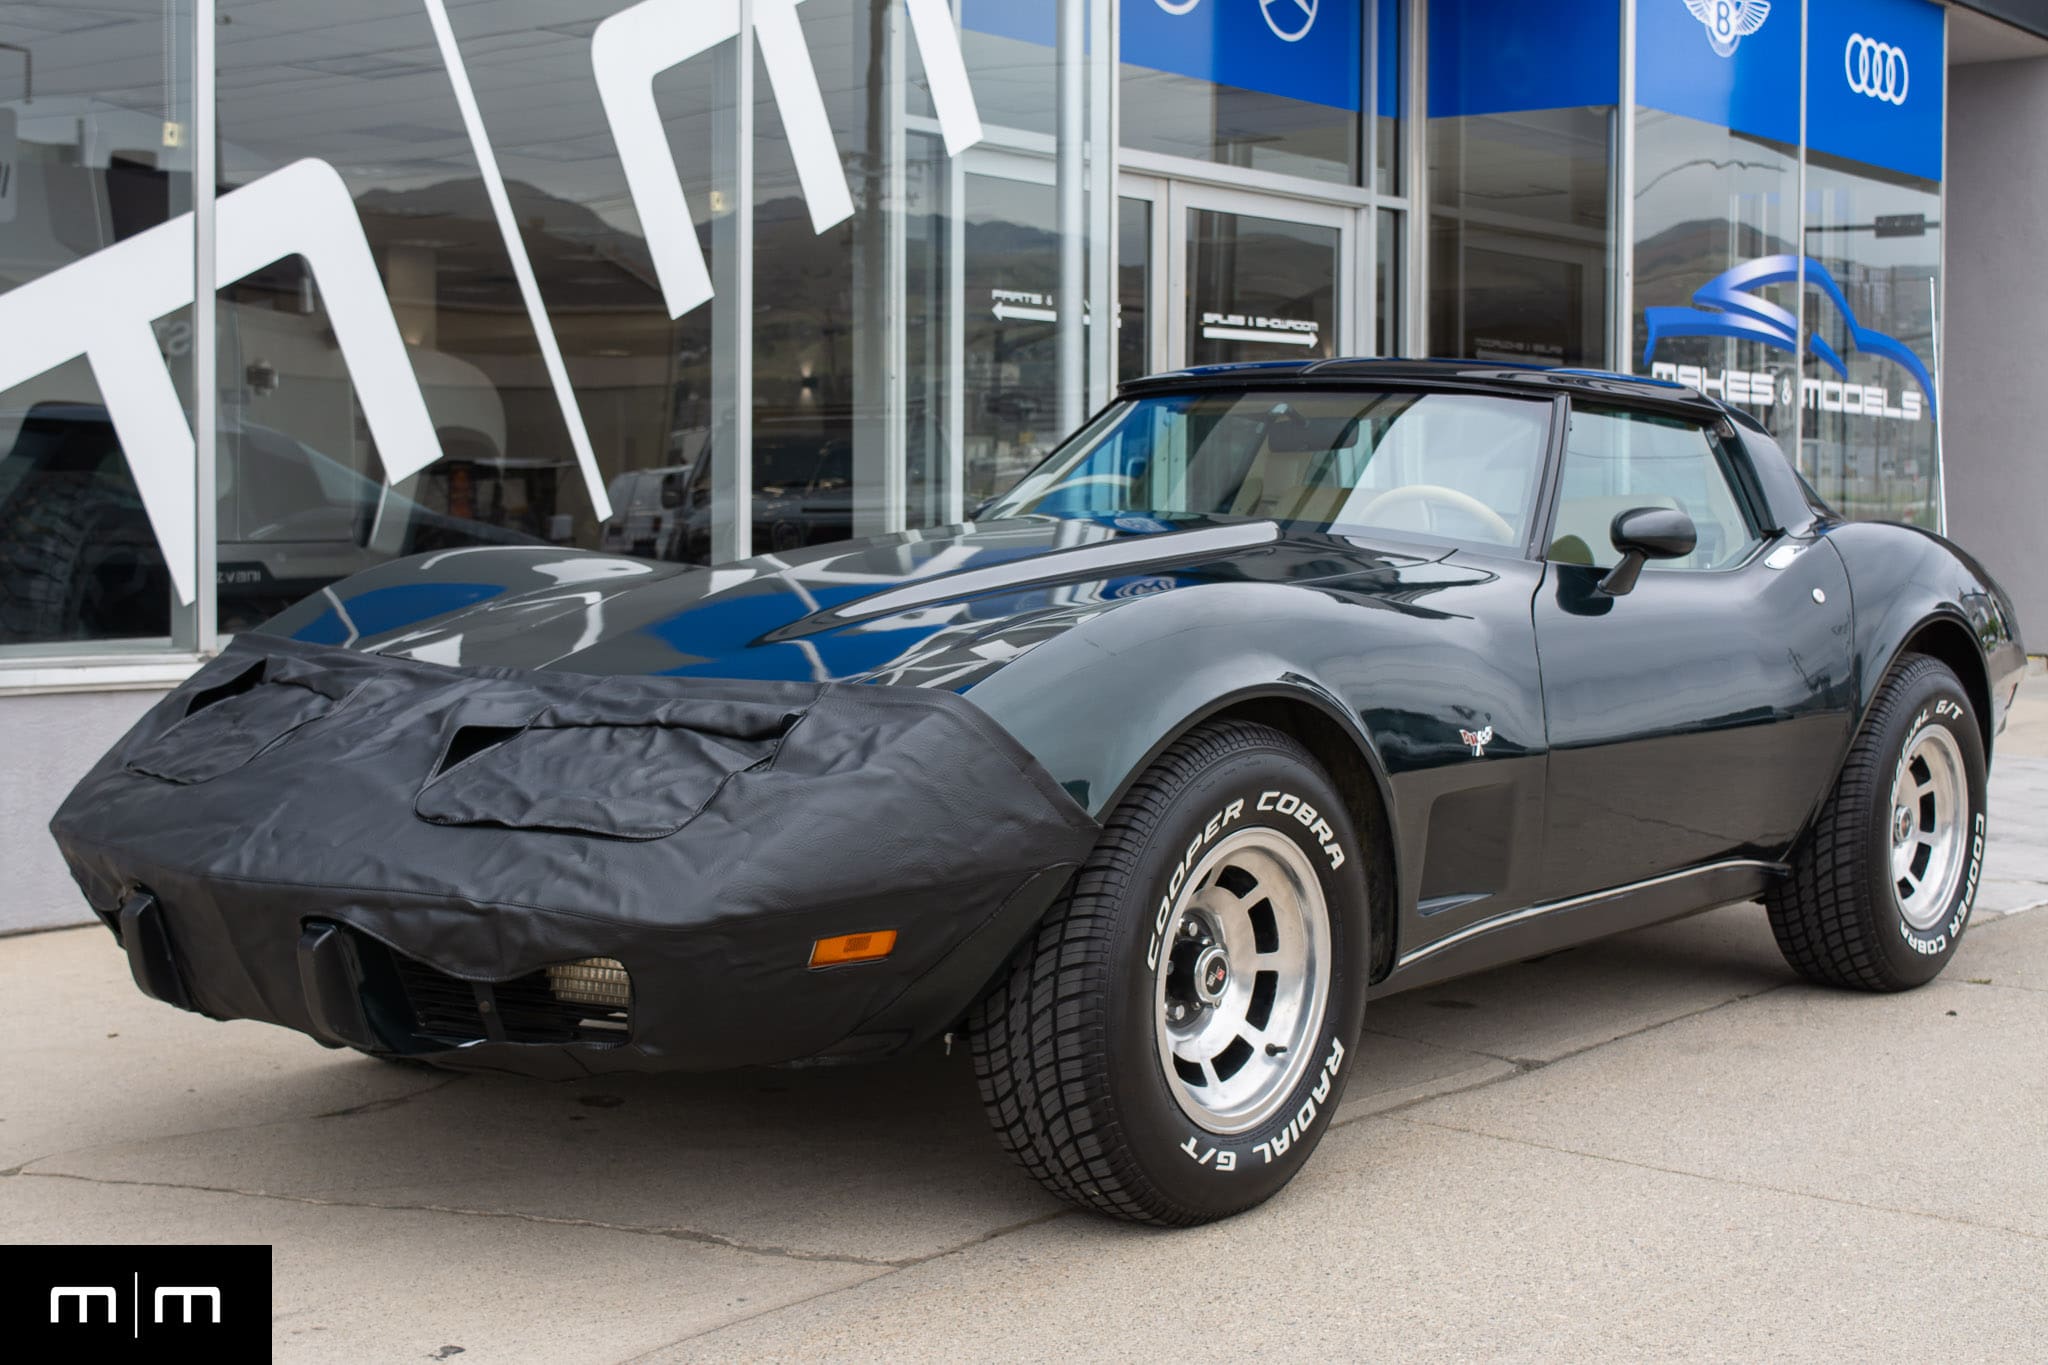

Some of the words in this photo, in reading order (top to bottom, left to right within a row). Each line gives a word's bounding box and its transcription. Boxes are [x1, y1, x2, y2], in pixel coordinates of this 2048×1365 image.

[1652, 362, 1774, 404] MAKES
[1781, 377, 1793, 405] &
[1801, 379, 1922, 420] MODELS
[1935, 700, 1963, 720] G/T
[1147, 798, 1244, 971] COOPER
[1256, 791, 1346, 871] COBRA
[1949, 813, 1984, 938] COOPER
[1900, 919, 1947, 955] COBRA
[1252, 1037, 1345, 1164] RADIAL
[1180, 1136, 1237, 1171] G/T
